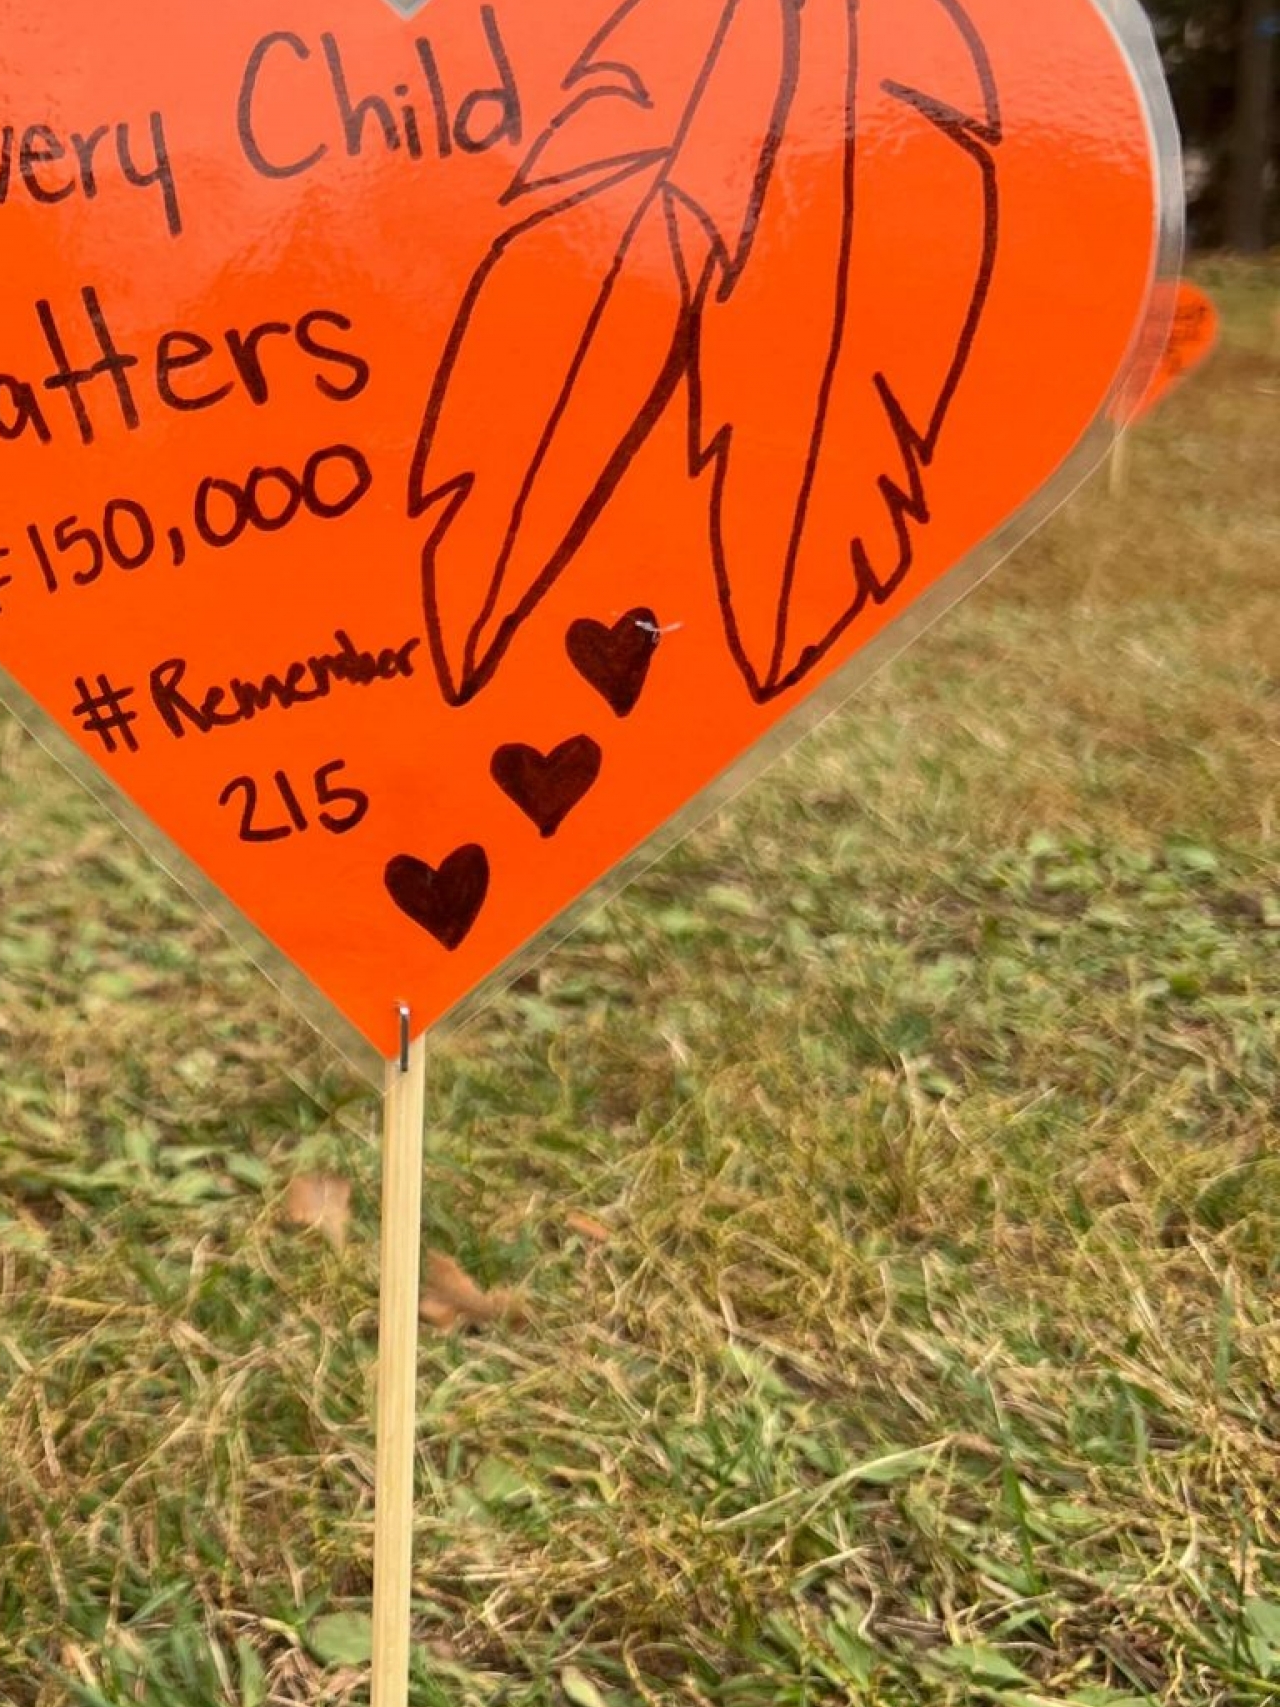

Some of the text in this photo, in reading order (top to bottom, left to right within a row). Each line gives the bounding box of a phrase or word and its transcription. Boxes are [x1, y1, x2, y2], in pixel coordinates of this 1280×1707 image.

[236, 3, 522, 180] Child
[72, 628, 421, 753] #Remember
[218, 759, 370, 843] 215
